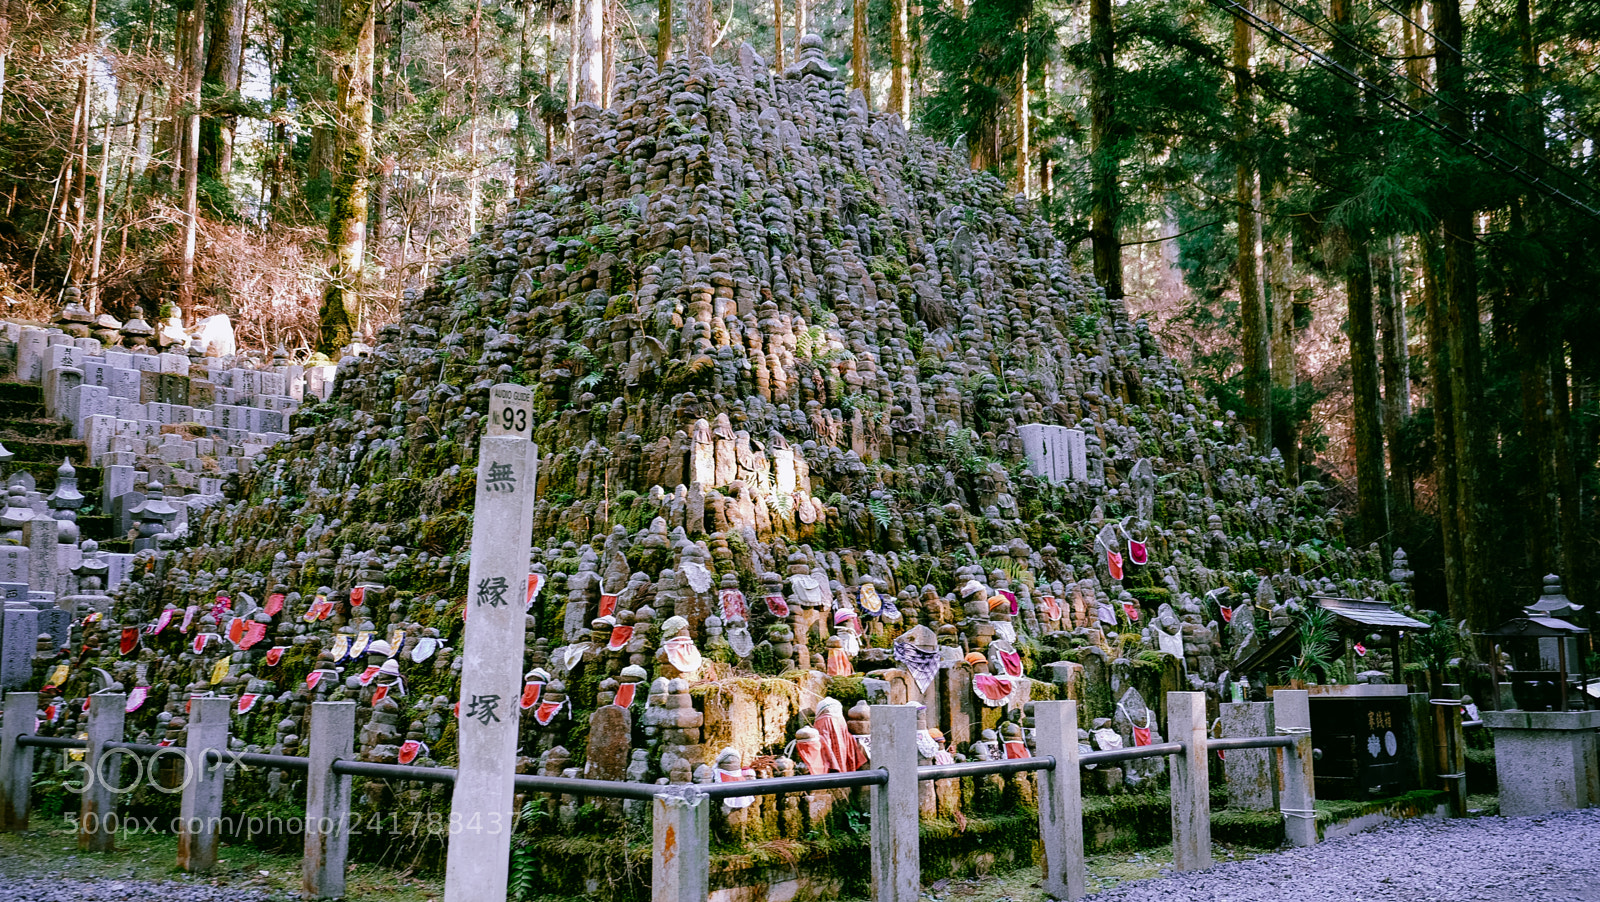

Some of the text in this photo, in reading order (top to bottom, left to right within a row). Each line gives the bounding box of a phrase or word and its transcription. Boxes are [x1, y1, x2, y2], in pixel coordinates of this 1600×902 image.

[494, 389, 530, 402] AUDIO GUIDE
[502, 406, 527, 432] 93
[466, 461, 517, 726] 無縁塚
